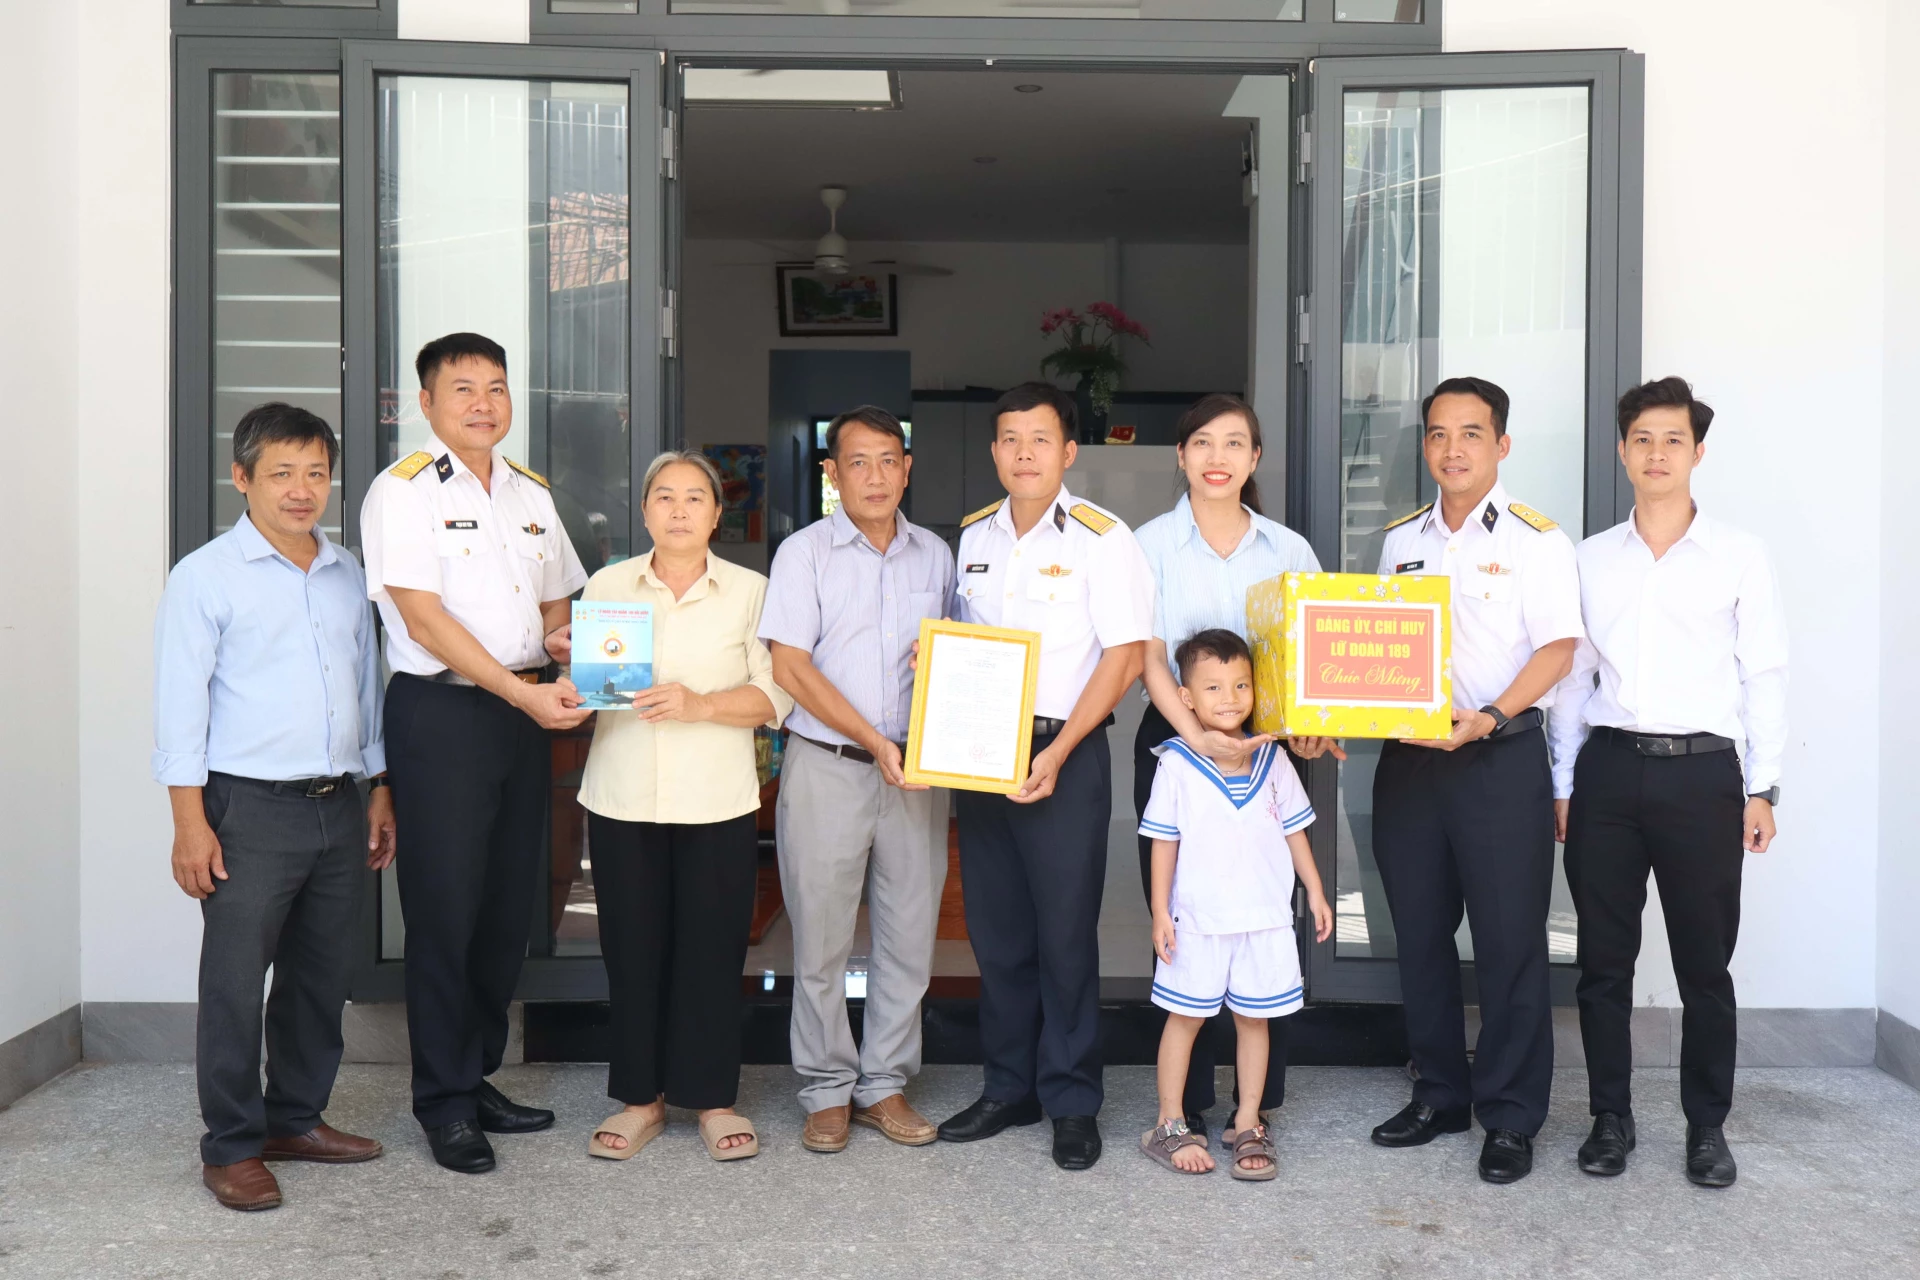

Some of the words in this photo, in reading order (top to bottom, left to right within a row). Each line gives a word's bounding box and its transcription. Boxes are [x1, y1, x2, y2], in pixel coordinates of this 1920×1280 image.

[1316, 615, 1350, 633] ĐẢNG
[1401, 621, 1425, 636] HUY
[1330, 640, 1347, 656] LỮ
[1350, 640, 1384, 657] ĐOÀN
[1388, 643, 1410, 658] 189
[1319, 662, 1361, 684] Chúc
[1365, 664, 1421, 694] Mừng
